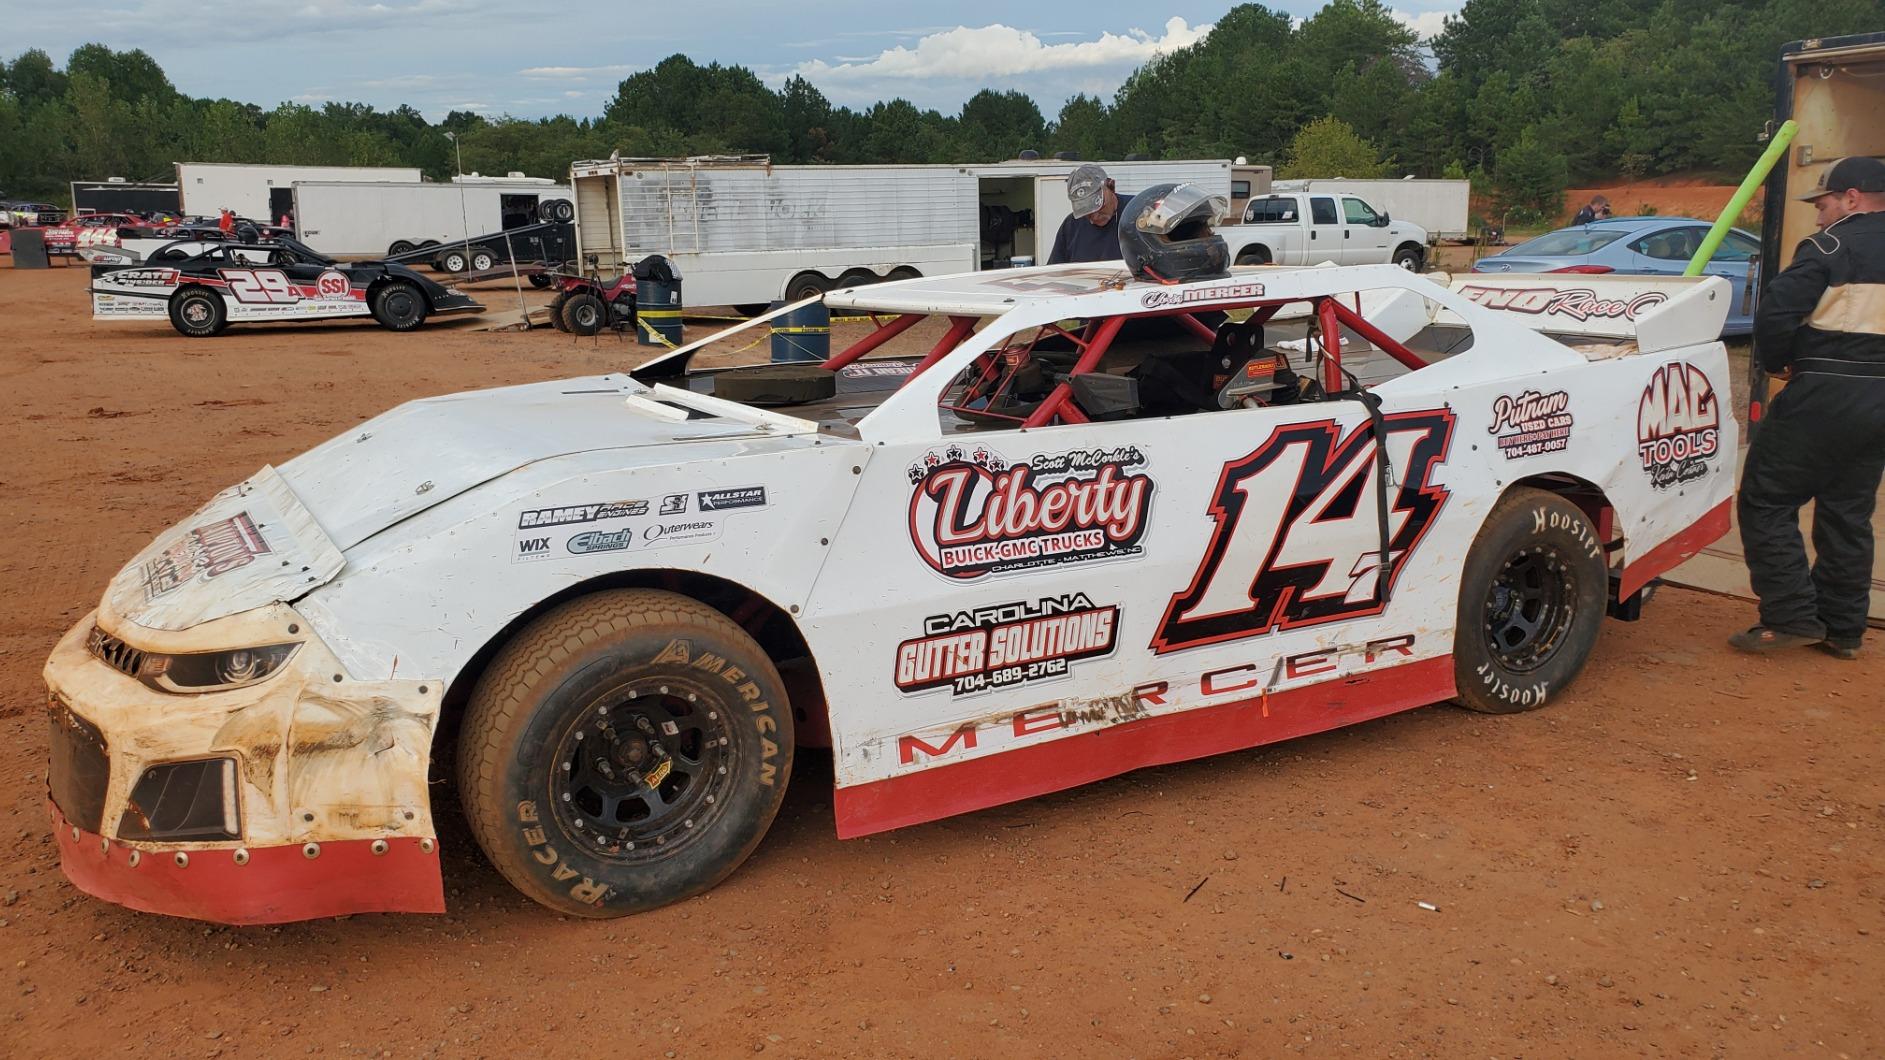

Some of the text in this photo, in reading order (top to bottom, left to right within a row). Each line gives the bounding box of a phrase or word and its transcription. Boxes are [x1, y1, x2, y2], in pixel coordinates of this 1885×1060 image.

[117, 271, 173, 279] CRATE
[320, 278, 346, 293] SSI
[1183, 284, 1265, 302] MERCER
[1489, 391, 1568, 434] Putnam
[1638, 362, 1719, 441] MAC
[1521, 415, 1572, 433] USED CARS
[1032, 446, 1140, 471] Scott McCorkle's
[1506, 438, 1566, 458] 704-487-0057
[1640, 430, 1717, 467] TOOLS
[712, 490, 762, 500] ALLSTAR
[927, 464, 1149, 543] Liberty
[519, 504, 601, 528] RAMEY
[520, 537, 551, 552] WIX
[643, 521, 714, 546] Outerwears
[1138, 407, 1457, 656] 14
[586, 543, 624, 551] SPRINGS
[943, 530, 1105, 569] BUICK-GMC TRUCKS
[991, 558, 1057, 573] CHARLOTTE
[925, 594, 1093, 635] CAROLINA
[898, 609, 1114, 684] GUTTER SOLUTIONS
[954, 659, 1067, 692] 704-689-2762
[651, 638, 778, 786] AMERICAN
[899, 633, 1416, 764] MERCER
[517, 800, 610, 904] RACER
